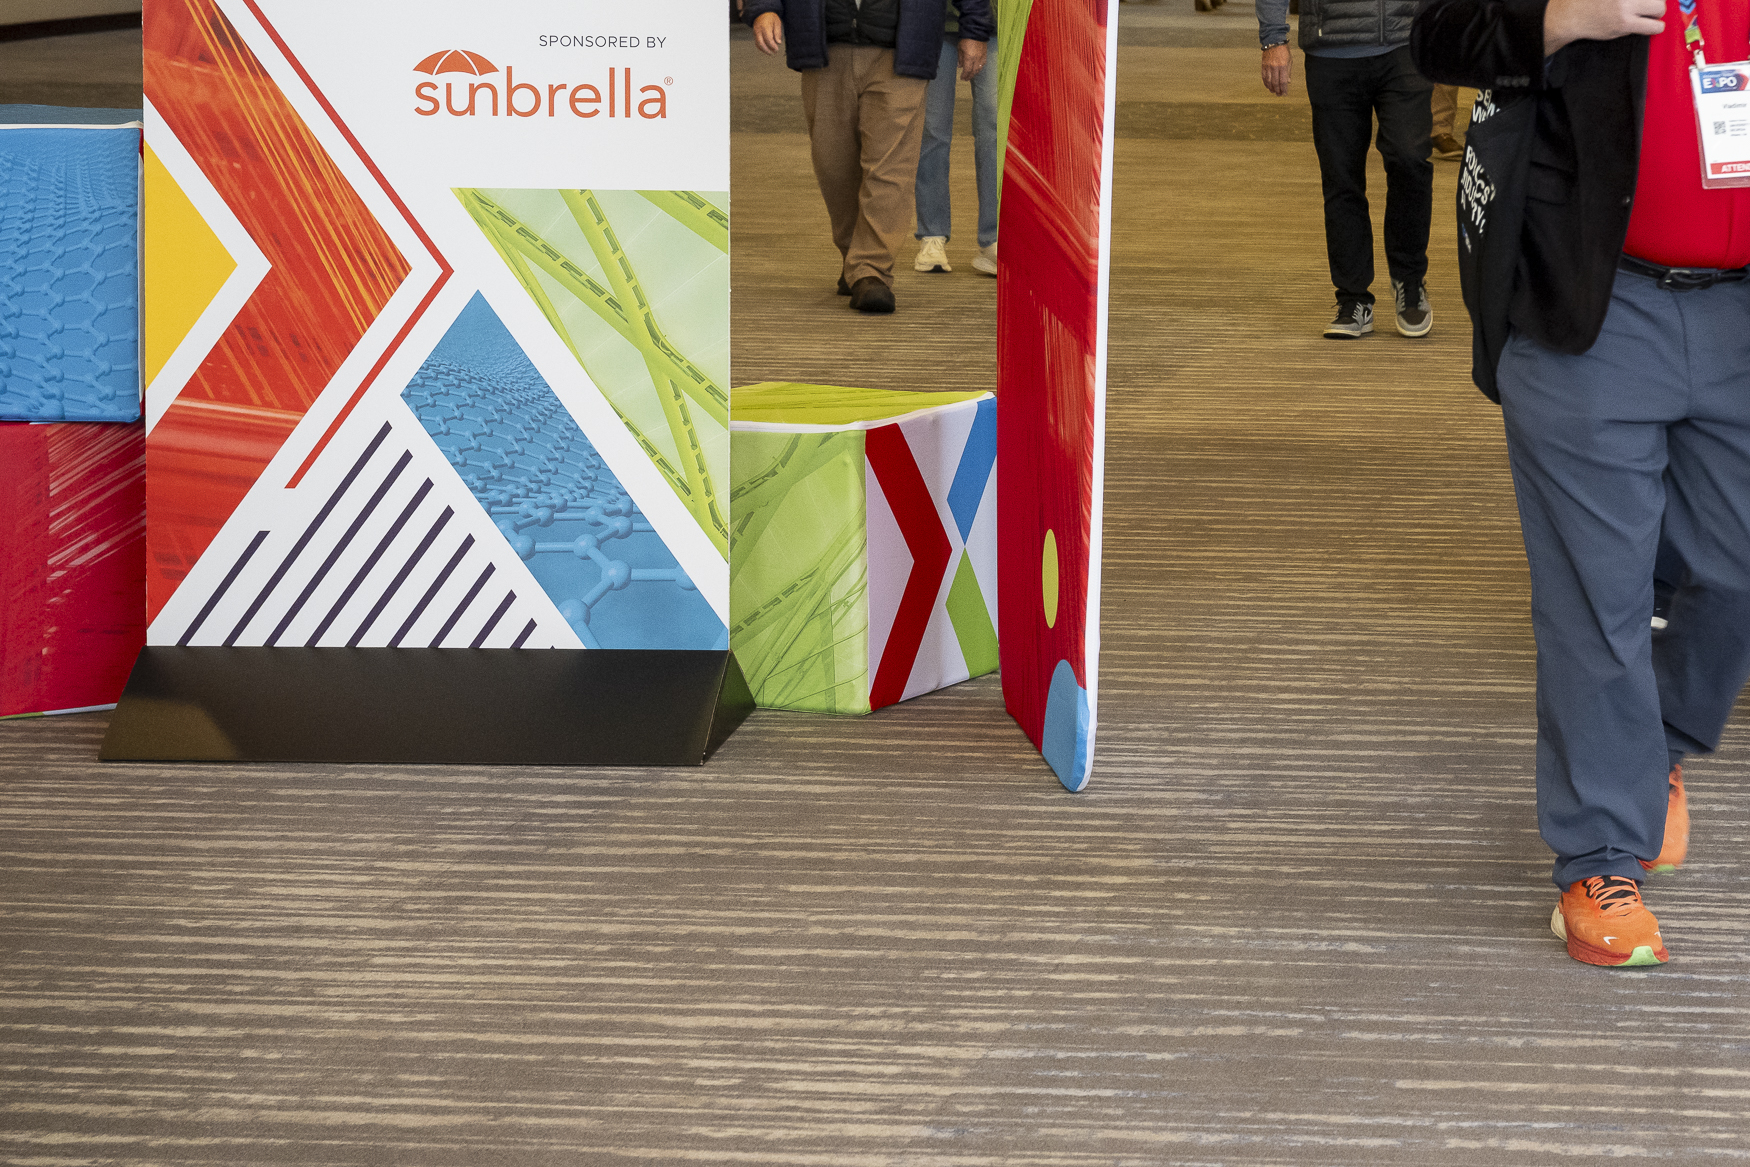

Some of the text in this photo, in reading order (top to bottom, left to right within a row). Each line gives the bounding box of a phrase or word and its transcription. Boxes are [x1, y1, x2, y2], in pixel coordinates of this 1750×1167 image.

[539, 35, 667, 49] SPONSORED BY
[1702, 76, 1737, 89] EXPO
